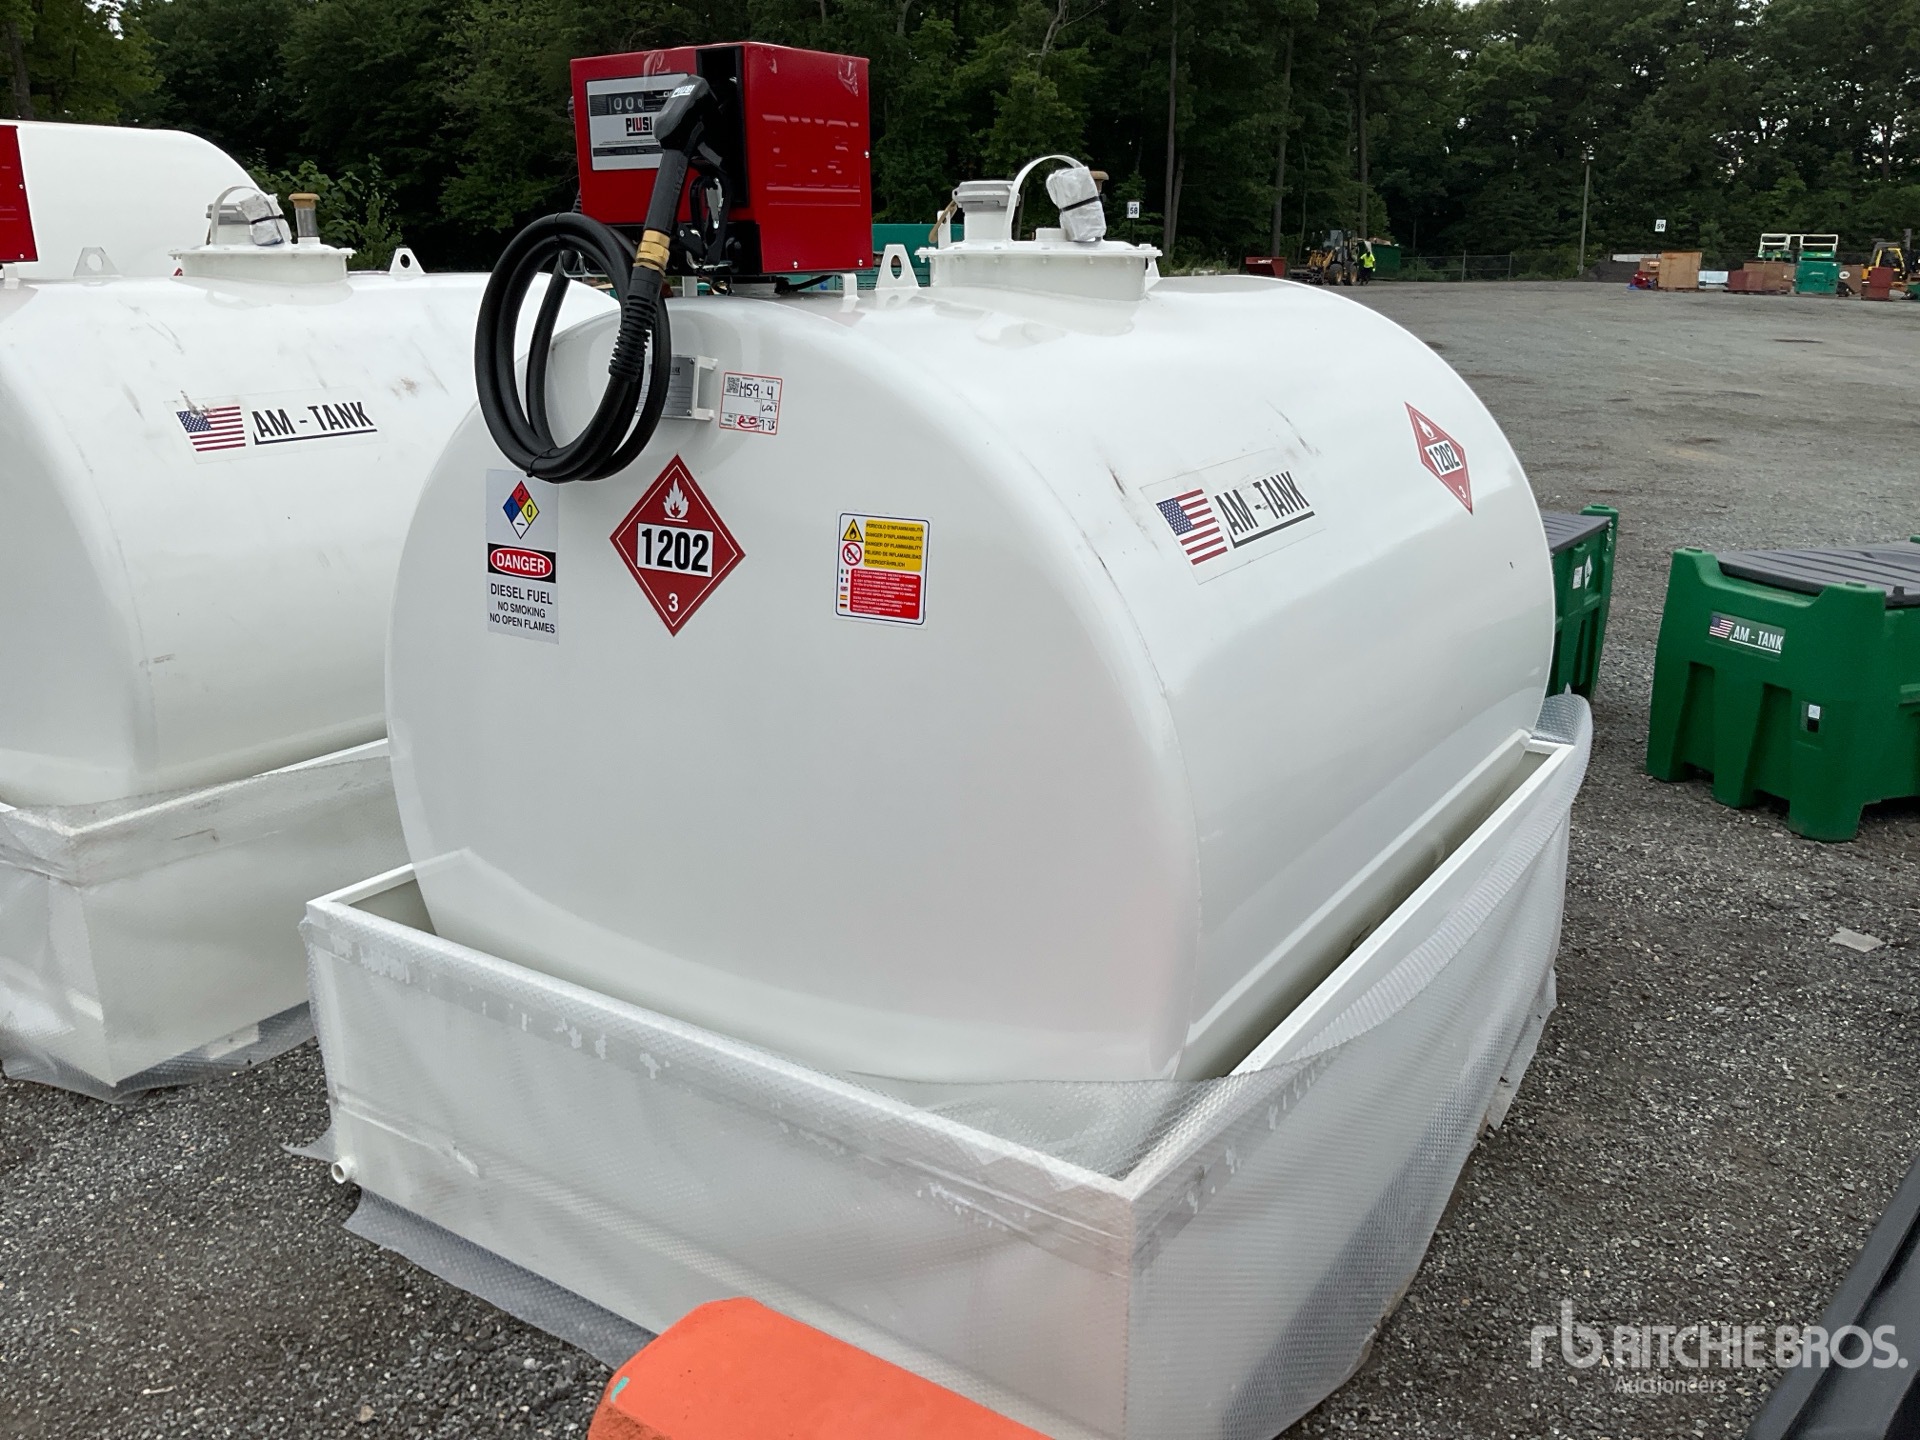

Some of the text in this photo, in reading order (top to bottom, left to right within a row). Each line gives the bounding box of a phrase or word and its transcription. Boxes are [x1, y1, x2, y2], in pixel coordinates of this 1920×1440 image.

[625, 116, 653, 132] PIUSI
[252, 408, 296, 438] AM
[307, 401, 374, 431] TANK
[1428, 443, 1461, 473] 1202
[1214, 489, 1259, 535] AM
[1252, 471, 1311, 519] TANK
[1458, 485, 1467, 499] 3
[526, 504, 533, 518] 0
[641, 528, 709, 573] 1202
[496, 552, 546, 574] DANGER
[490, 583, 553, 605] DIESEL FUEL
[668, 592, 679, 612] 3
[497, 601, 546, 618] NO SMOKING
[489, 613, 556, 634] NO OPEN FLAMES
[1733, 626, 1750, 642] AM
[1757, 630, 1783, 650] TANK
